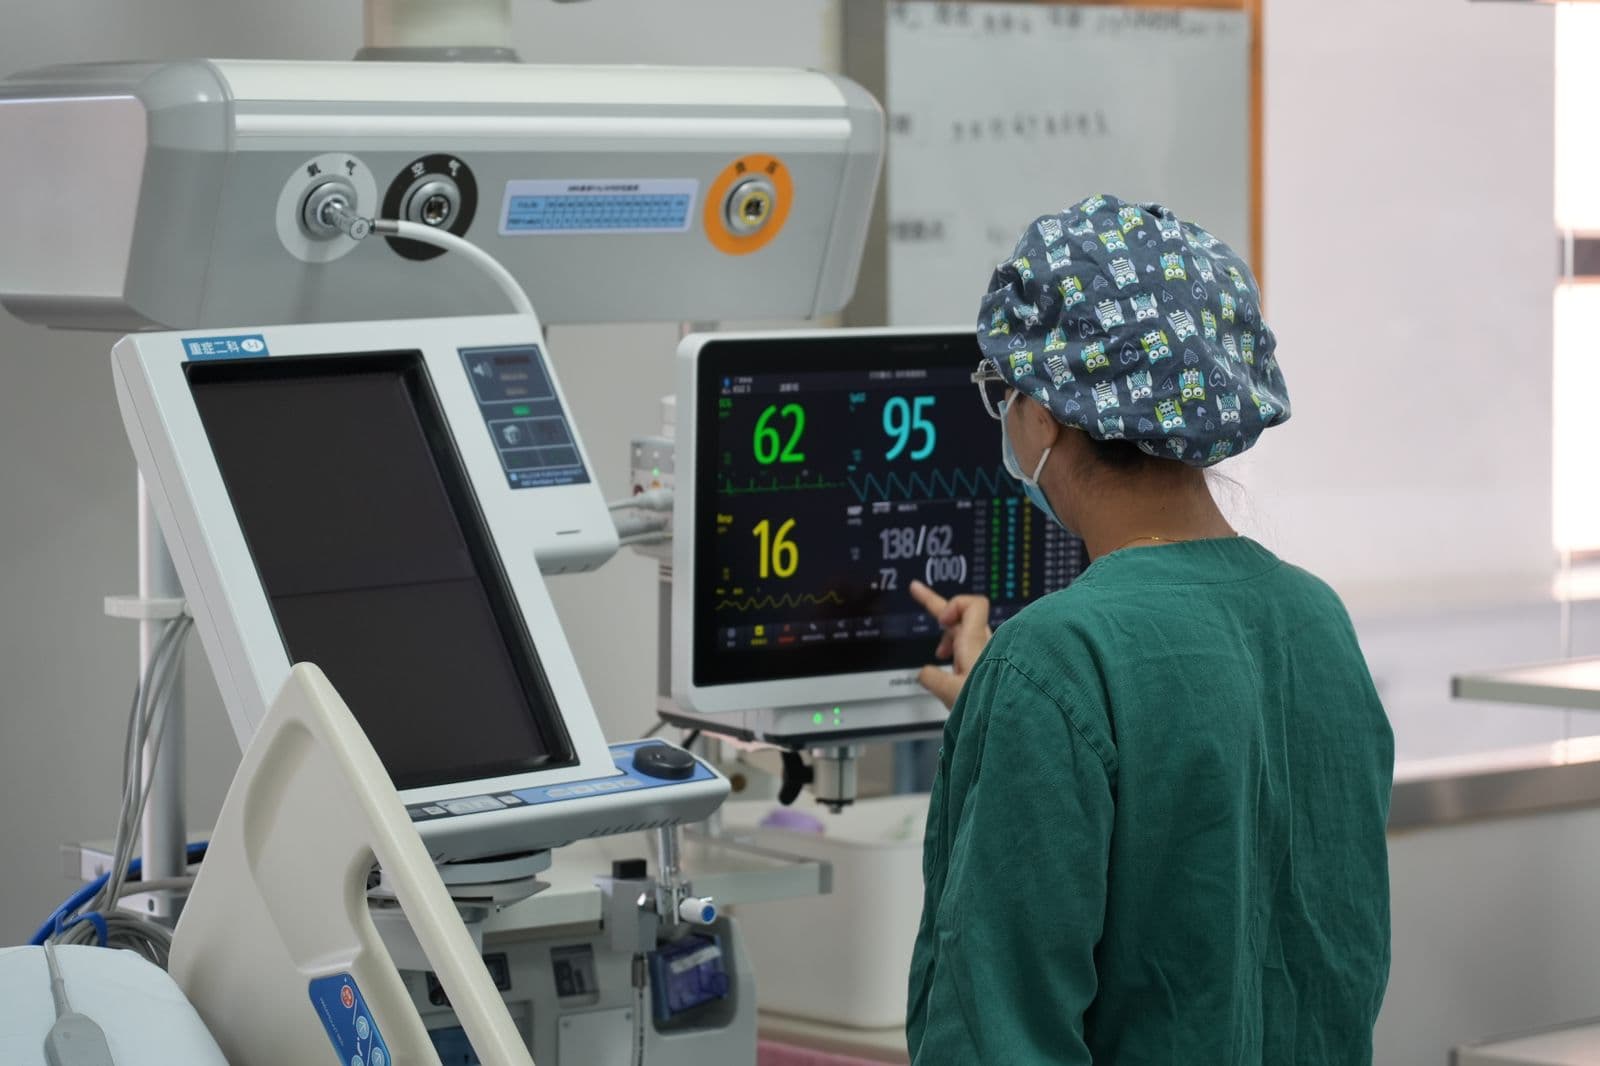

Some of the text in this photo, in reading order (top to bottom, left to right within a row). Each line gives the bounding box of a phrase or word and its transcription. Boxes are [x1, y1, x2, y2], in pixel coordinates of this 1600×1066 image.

[189, 341, 240, 355] 重症二科
[753, 403, 805, 465] 62
[882, 396, 936, 461] 95
[752, 518, 799, 578] 16
[879, 524, 953, 560] 138/62
[880, 567, 898, 590] 72
[925, 555, 968, 586] (100)
